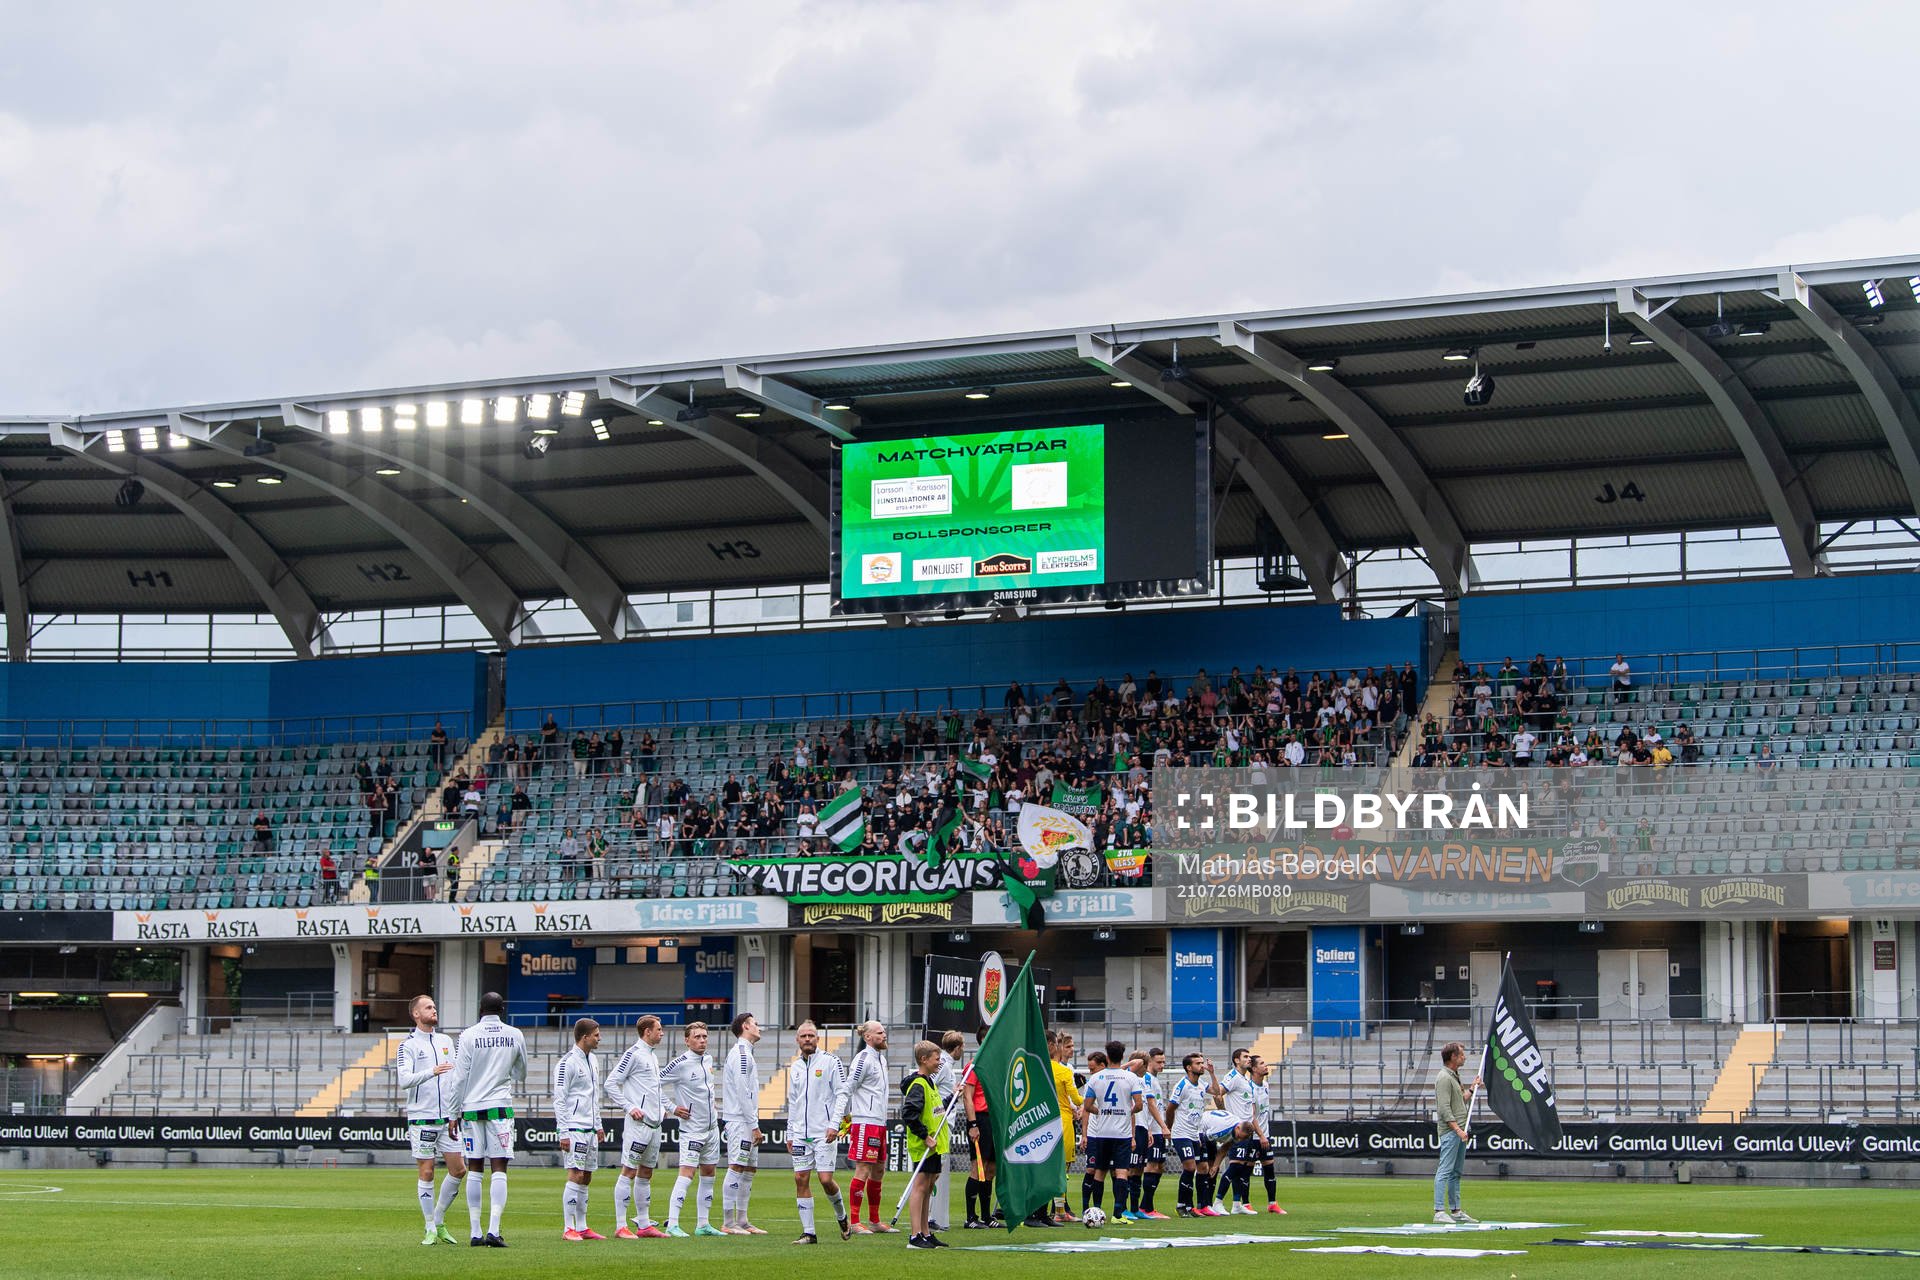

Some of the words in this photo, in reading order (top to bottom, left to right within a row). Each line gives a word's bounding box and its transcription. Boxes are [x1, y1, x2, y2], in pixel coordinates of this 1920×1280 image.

[877, 439, 1068, 463] MATCHVÄRDAR
[1595, 482, 1646, 504] J4
[892, 522, 1052, 541] BOLLSPONSORER
[707, 540, 761, 560] H3
[127, 570, 173, 588] H1
[357, 564, 411, 582] H2
[993, 589, 1037, 601] SAMSUNG
[402, 851, 421, 867] H2
[1206, 843, 1554, 886] GÅRDAKVARNEN
[915, 860, 994, 890] GAIS
[1700, 881, 1786, 908] KOPPARBERG
[1866, 878, 1920, 897] Idre
[1066, 895, 1117, 916] Fjäll
[1270, 891, 1348, 915] KOPPARBERG
[1606, 884, 1691, 910] KOPPARBERG
[652, 905, 694, 921] Idre
[697, 903, 743, 923] Fjäll
[803, 903, 873, 925] KOPPARBERG
[881, 902, 952, 924] KOPPARBERG
[138, 923, 190, 939] RASTA
[207, 921, 259, 938] RASTA
[297, 919, 350, 936] RASTA
[368, 917, 422, 934] RASTA
[460, 915, 517, 933] RASTA
[535, 914, 592, 931] RASTA
[1100, 931, 1109, 939] G5
[520, 953, 577, 976] Sofiero
[695, 950, 735, 973] Sofie
[1175, 952, 1213, 967] Sofiero
[1316, 949, 1356, 964] Sofiero
[936, 973, 973, 997] UNIBET
[475, 1036, 515, 1048] ATLETERNA
[1104, 1080, 1118, 1106] 4
[1008, 1101, 1051, 1140] SUPERETTAN
[0, 1126, 31, 1138] amla
[34, 1126, 69, 1138] Ullevi
[75, 1126, 116, 1139] Gamla
[118, 1126, 155, 1139] Ullevi
[161, 1126, 203, 1139] Gamla
[205, 1126, 242, 1139] Ullevi
[249, 1127, 292, 1140] Gamla
[295, 1127, 332, 1140] Ullevi
[339, 1127, 383, 1141] Gamla
[386, 1127, 410, 1141] Ulle
[524, 1128, 559, 1142] Gam
[1029, 1131, 1054, 1150] OBOS
[1270, 1133, 1308, 1148] amla
[1312, 1133, 1359, 1149] Ullevi
[1368, 1133, 1425, 1149] Gamla
[1429, 1135, 1477, 1149] Uvi
[1487, 1134, 1531, 1150] Gam
[1608, 1135, 1667, 1151] Gamla
[1672, 1135, 1723, 1151] Ullevi
[1733, 1135, 1794, 1151] Gamla
[1798, 1135, 1850, 1151] Ullevi
[889, 1138, 900, 1171] SELECT
[1130, 1153, 1139, 1164] 10
[1152, 1147, 1160, 1158] 11
[1182, 1147, 1193, 1157] 13
[1236, 1148, 1246, 1158] 21
